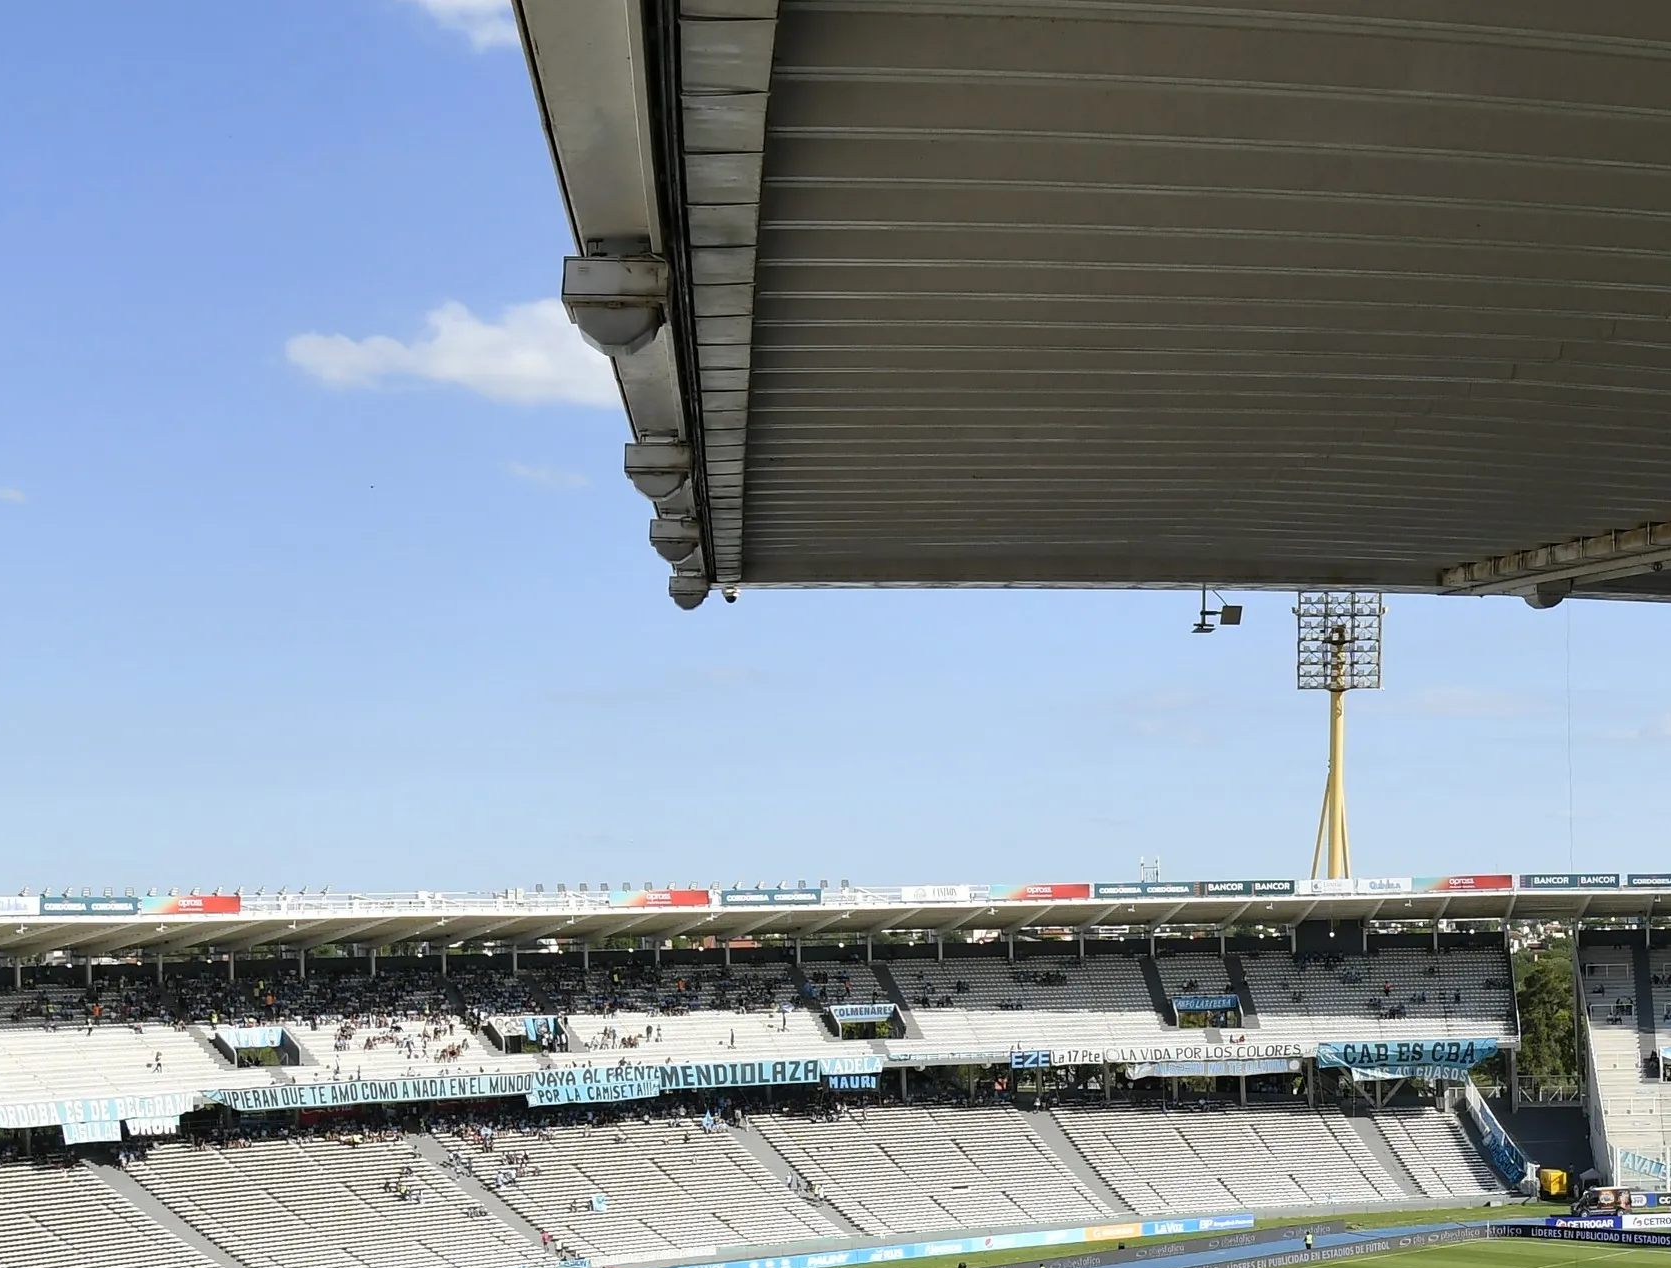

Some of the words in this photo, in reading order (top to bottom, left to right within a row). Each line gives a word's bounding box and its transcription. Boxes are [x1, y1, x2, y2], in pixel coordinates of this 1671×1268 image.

[1207, 882, 1244, 892] BANCOR
[1254, 882, 1290, 891] BANCOR
[1533, 877, 1569, 885] BANCOR
[1580, 876, 1616, 884] BANCOR
[834, 1006, 894, 1017] COLMENARES
[1012, 1051, 1050, 1068] EZE
[1051, 1050, 1066, 1064] La
[1067, 1049, 1079, 1063] 17
[1081, 1048, 1102, 1063] Pte
[1120, 1049, 1137, 1061] LA
[1141, 1047, 1172, 1061] VIDA
[1176, 1046, 1202, 1060] POR
[1205, 1046, 1233, 1059] LOS
[1236, 1043, 1302, 1058] COLORES
[1343, 1042, 1389, 1063] CAB
[1396, 1042, 1425, 1062] ES
[1431, 1041, 1476, 1064] CBA
[533, 1068, 576, 1087] VAYA
[582, 1068, 602, 1085] AL
[658, 1059, 820, 1087] MENDIOLAZA
[829, 1075, 877, 1089] MAURI
[221, 1086, 279, 1110] UPIERAN
[281, 1085, 306, 1107] QUE
[309, 1084, 328, 1104] TE
[331, 1081, 359, 1102] AMO
[361, 1080, 399, 1101] COMO
[412, 1077, 447, 1098] NADA
[449, 1077, 468, 1096] EN
[470, 1076, 485, 1094] EL
[488, 1072, 532, 1094] MUNDO
[537, 1089, 560, 1105] POR
[565, 1087, 583, 1102] LA
[1568, 1219, 1614, 1229] CETROGAR
[1531, 1226, 1562, 1238] LÍDERES
[1563, 1229, 1574, 1240] EN
[1576, 1230, 1620, 1242] PUBLICIDAD
[1622, 1232, 1632, 1243] EN
[1633, 1234, 1670, 1245] ESTADIOS
[1269, 1252, 1309, 1268] PUBLICIDAD
[1311, 1250, 1321, 1263] EN
[1322, 1247, 1355, 1261] ESTADIOS
[1356, 1244, 1365, 1256] DE
[1366, 1240, 1390, 1253] FÚTBOL
